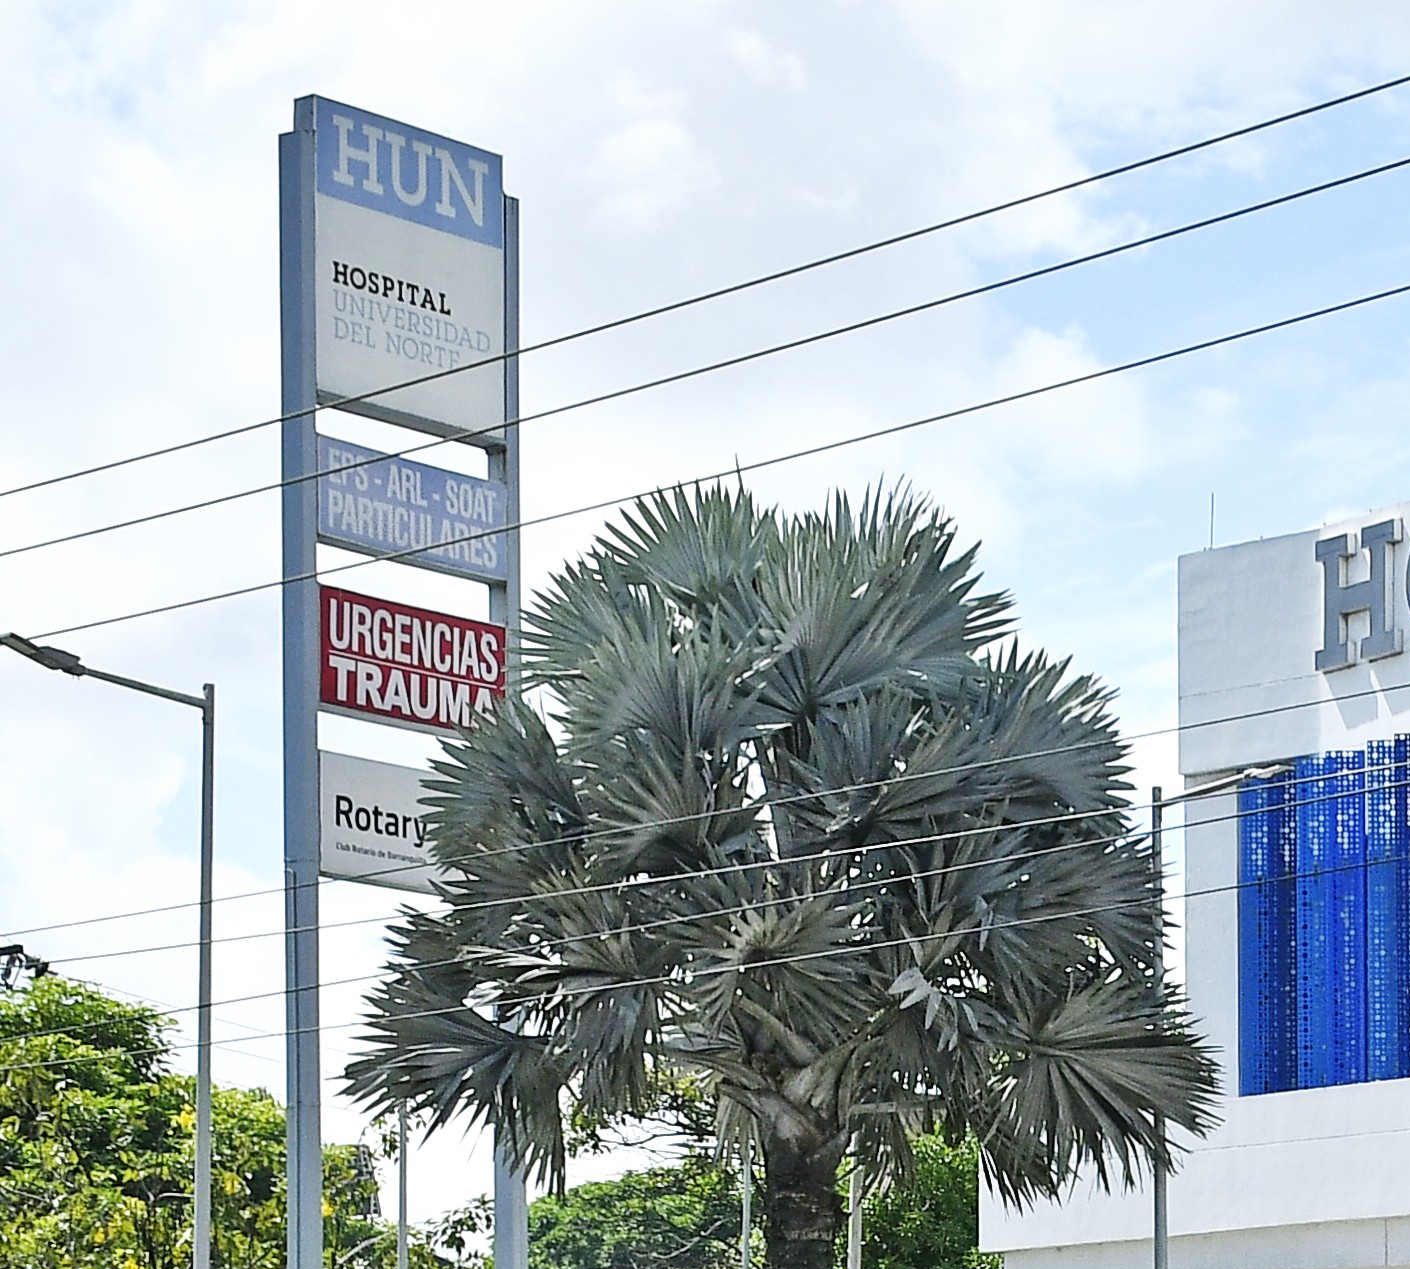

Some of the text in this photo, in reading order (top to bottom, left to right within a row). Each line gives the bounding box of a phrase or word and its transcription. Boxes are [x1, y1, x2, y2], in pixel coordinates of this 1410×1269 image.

[332, 114, 489, 227] HUN
[332, 260, 452, 316] HOSPITAL
[333, 289, 491, 353] UNIVERSIDAD
[333, 316, 460, 369] DEL NORTE
[327, 446, 369, 492] EPS
[386, 463, 428, 508] ARL
[445, 476, 498, 525] SOAT
[327, 487, 498, 570] PARTICULARES
[328, 597, 499, 683] URGENCIAS
[328, 653, 498, 730] TRAUMA
[335, 794, 428, 849] Rotary
